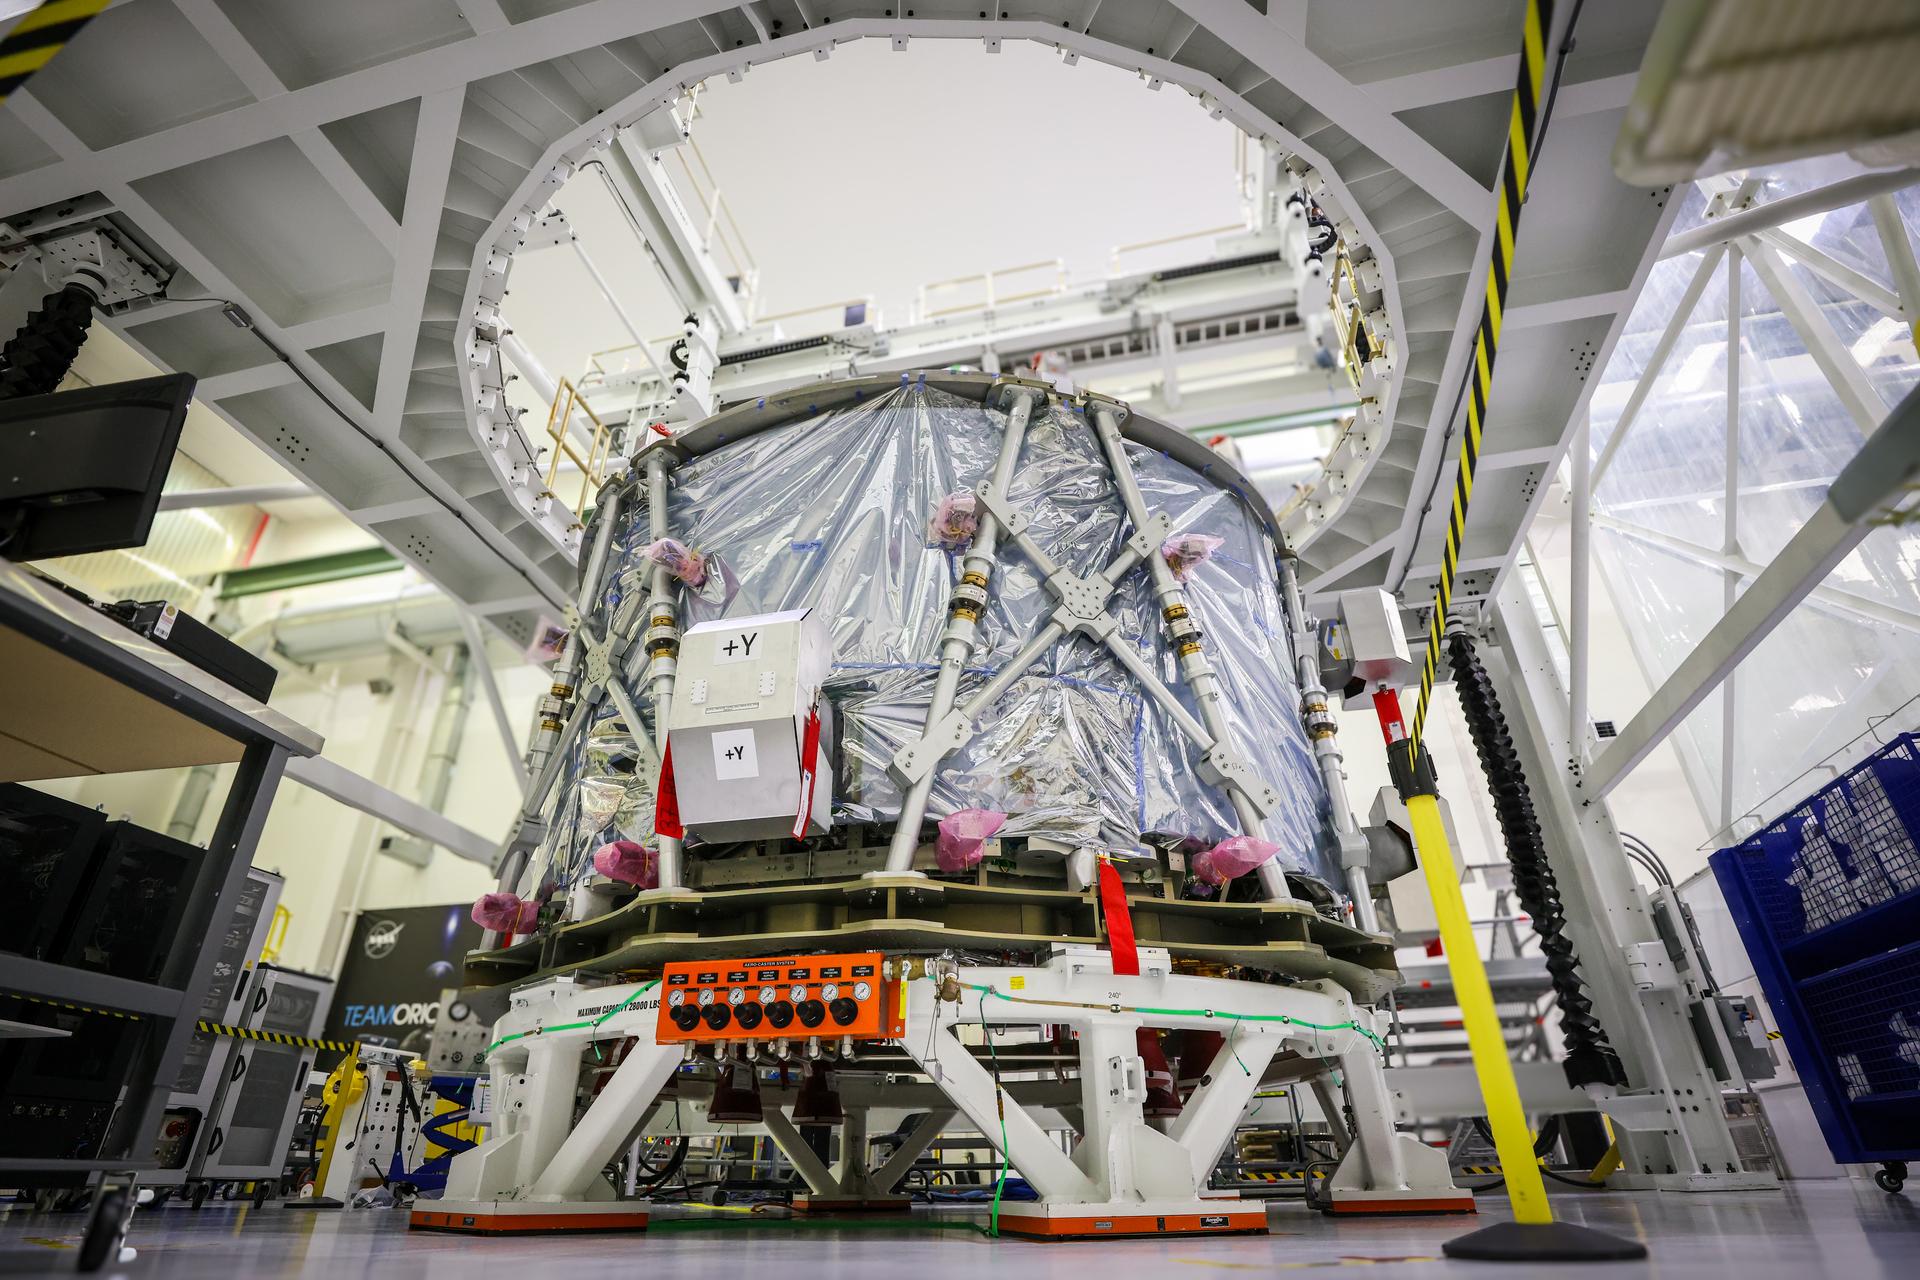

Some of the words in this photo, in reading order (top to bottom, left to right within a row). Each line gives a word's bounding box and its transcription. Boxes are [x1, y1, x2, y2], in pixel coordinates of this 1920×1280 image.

[723, 632, 757, 656] +Y
[725, 746, 744, 760] +Y
[577, 1006, 602, 1017] MAXIMUM
[629, 1000, 648, 1011] 28000
[649, 999, 661, 1009] LBS
